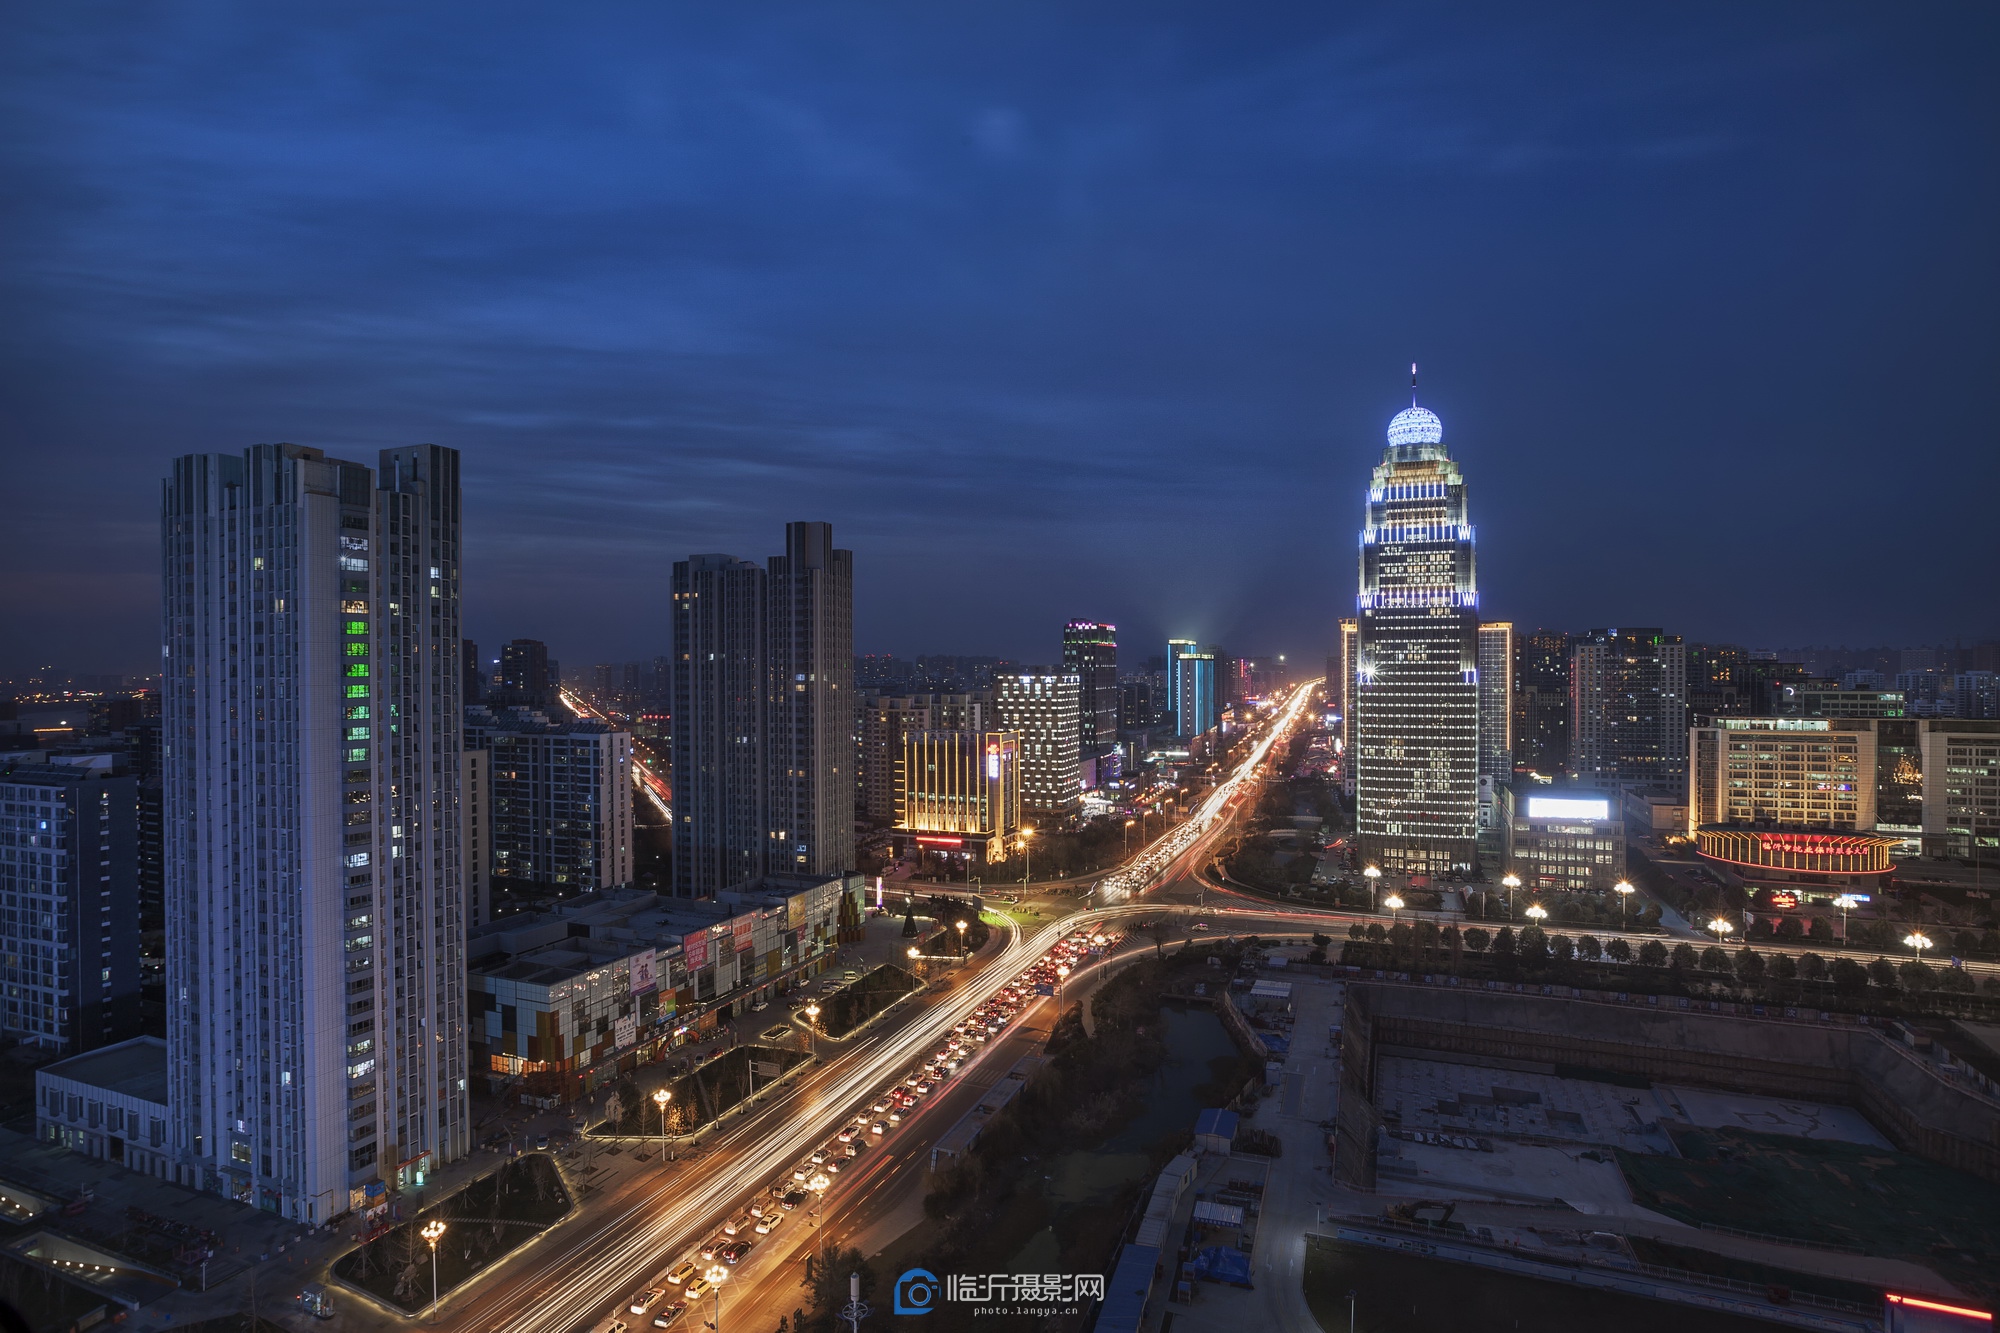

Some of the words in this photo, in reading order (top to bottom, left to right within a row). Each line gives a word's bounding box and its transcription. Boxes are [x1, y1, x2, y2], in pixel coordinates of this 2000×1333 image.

[1762, 842, 1869, 855] 临沂市就业保障服务大厅
